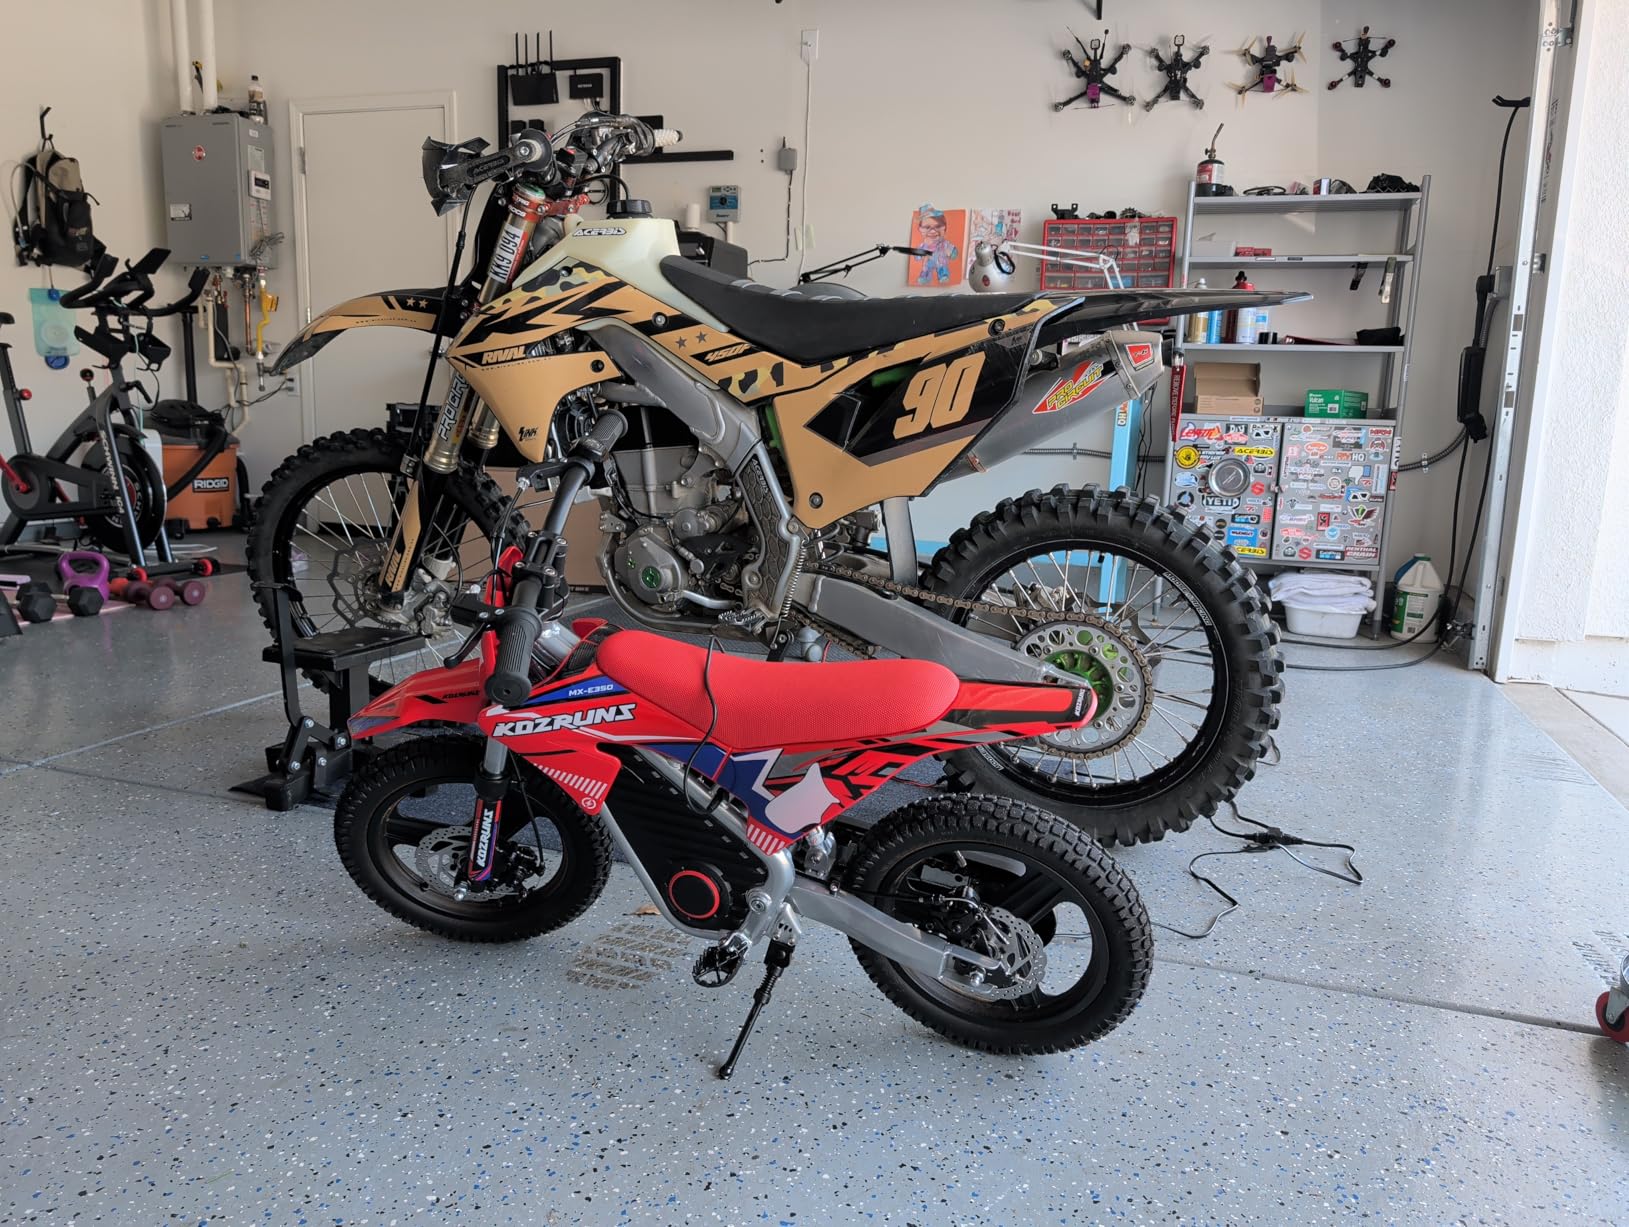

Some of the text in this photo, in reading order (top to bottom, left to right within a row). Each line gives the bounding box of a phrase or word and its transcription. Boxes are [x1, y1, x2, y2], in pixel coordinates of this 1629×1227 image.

[572, 227, 627, 237] ACERBIS
[481, 345, 526, 365] RIVAL
[892, 350, 987, 440] 90
[1046, 380, 1074, 410] PRO
[1056, 363, 1104, 409] CIRCUIT
[438, 405, 458, 441] PRO
[101, 429, 119, 490] SCHWINN
[193, 479, 229, 489] RIDGID
[1206, 497, 1233, 506] YETI
[568, 683, 614, 698] MX-E350
[491, 702, 637, 738] KOZRUNS
[475, 808, 495, 868] KOZRUNS
